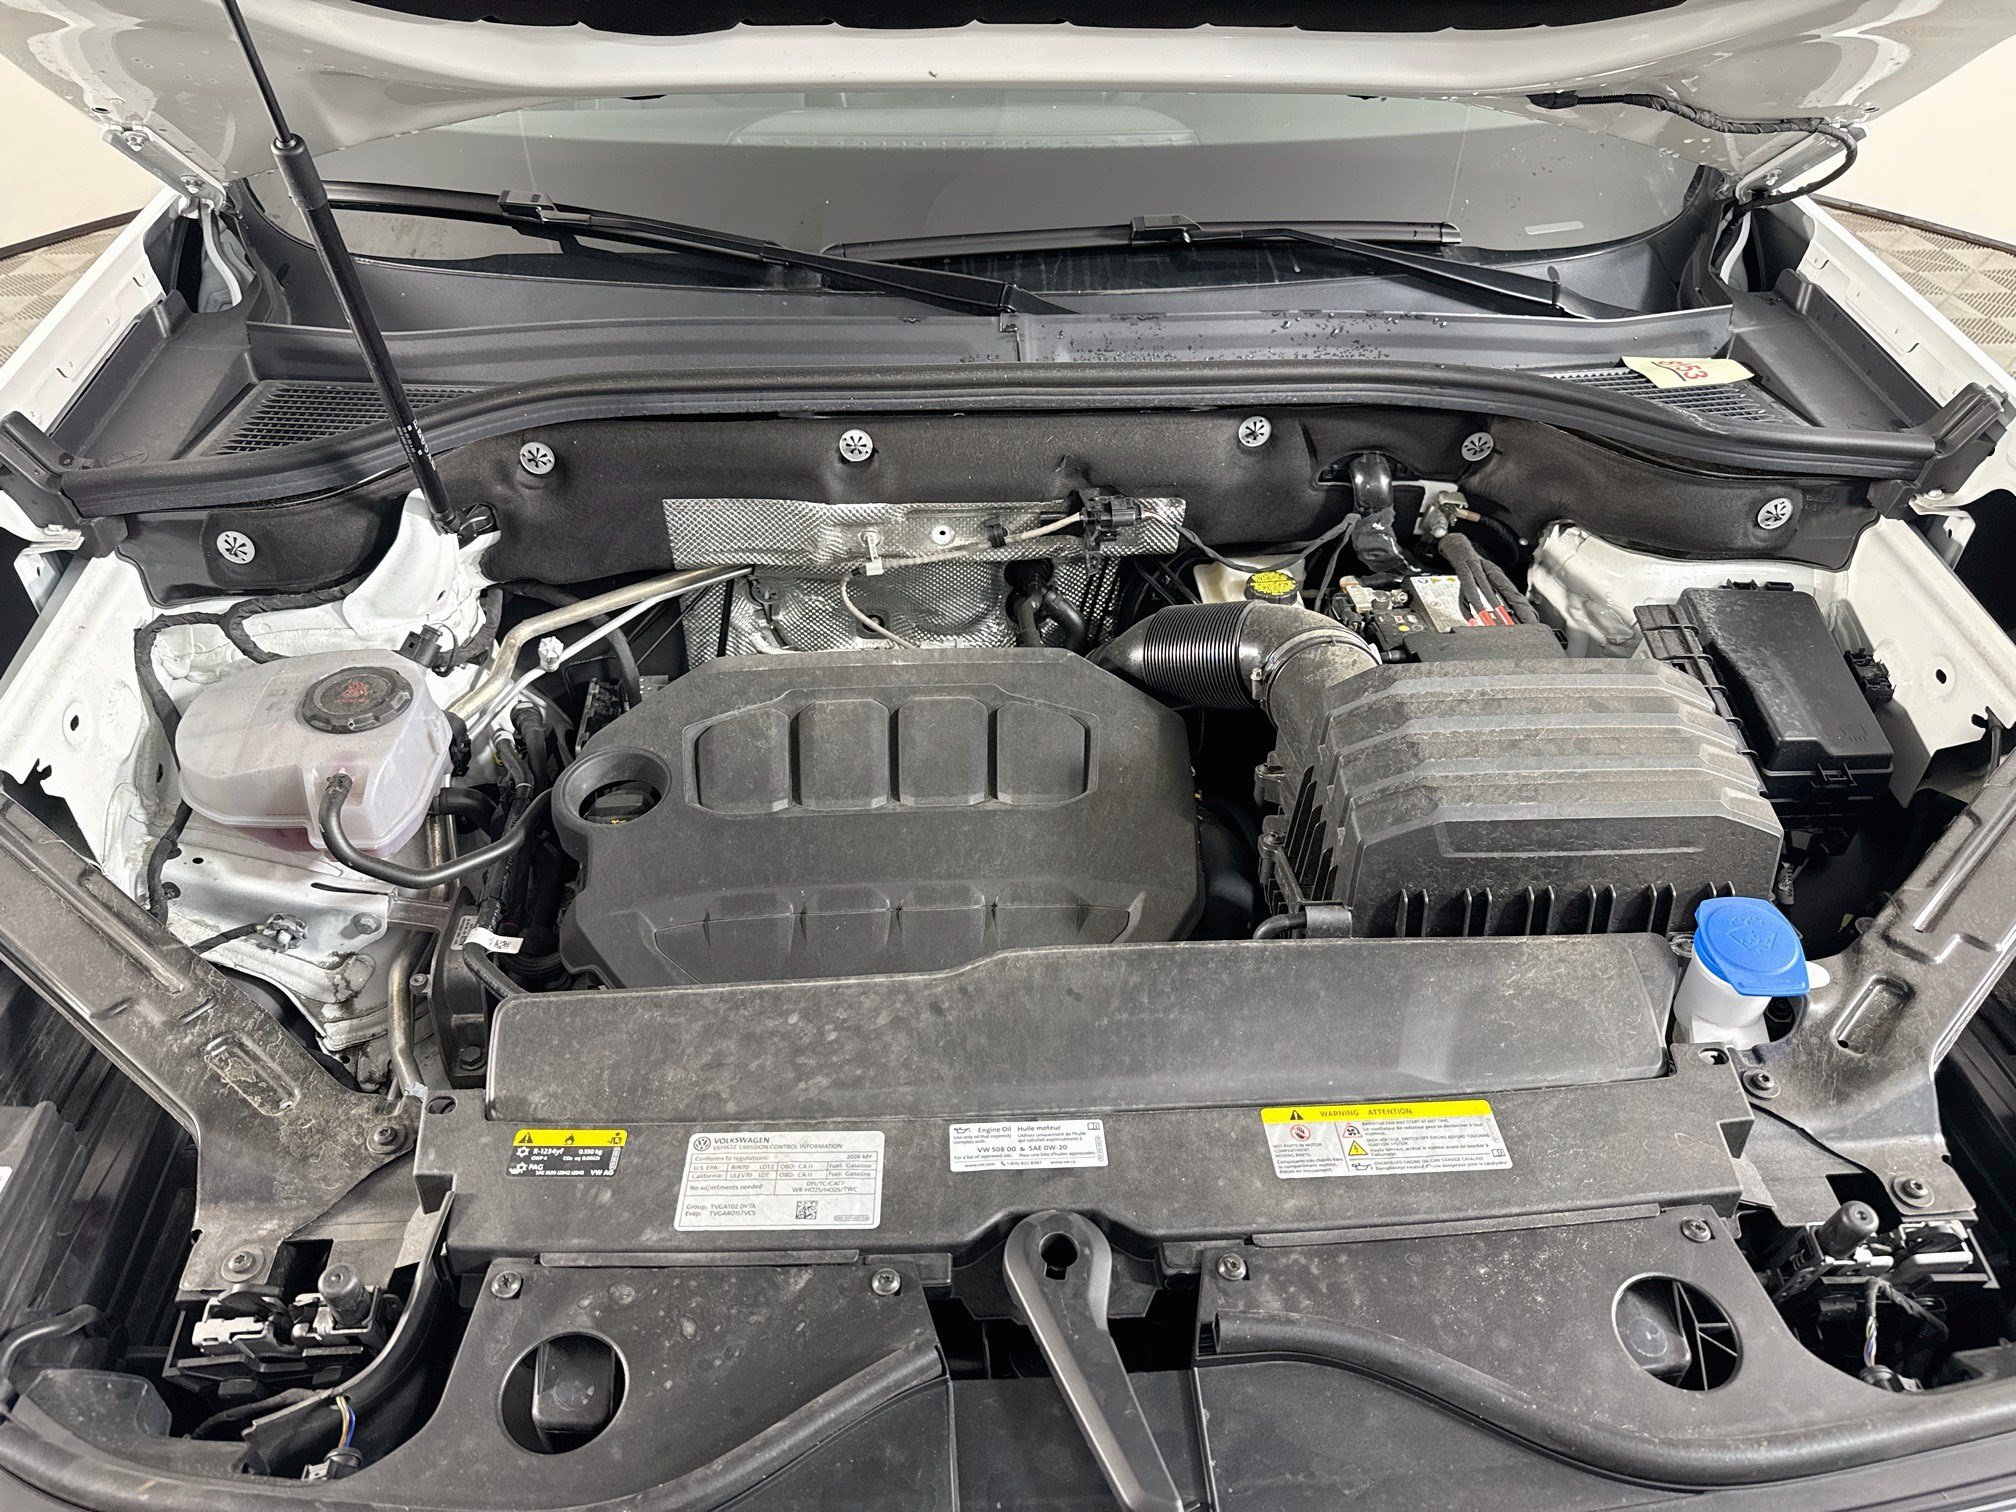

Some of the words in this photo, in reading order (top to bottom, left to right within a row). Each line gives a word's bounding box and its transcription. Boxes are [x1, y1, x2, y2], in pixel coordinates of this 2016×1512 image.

[1368, 1108, 1413, 1116] ATTENTION
[533, 1147, 565, 1157] R-1234yf
[528, 1163, 544, 1171] PAG
